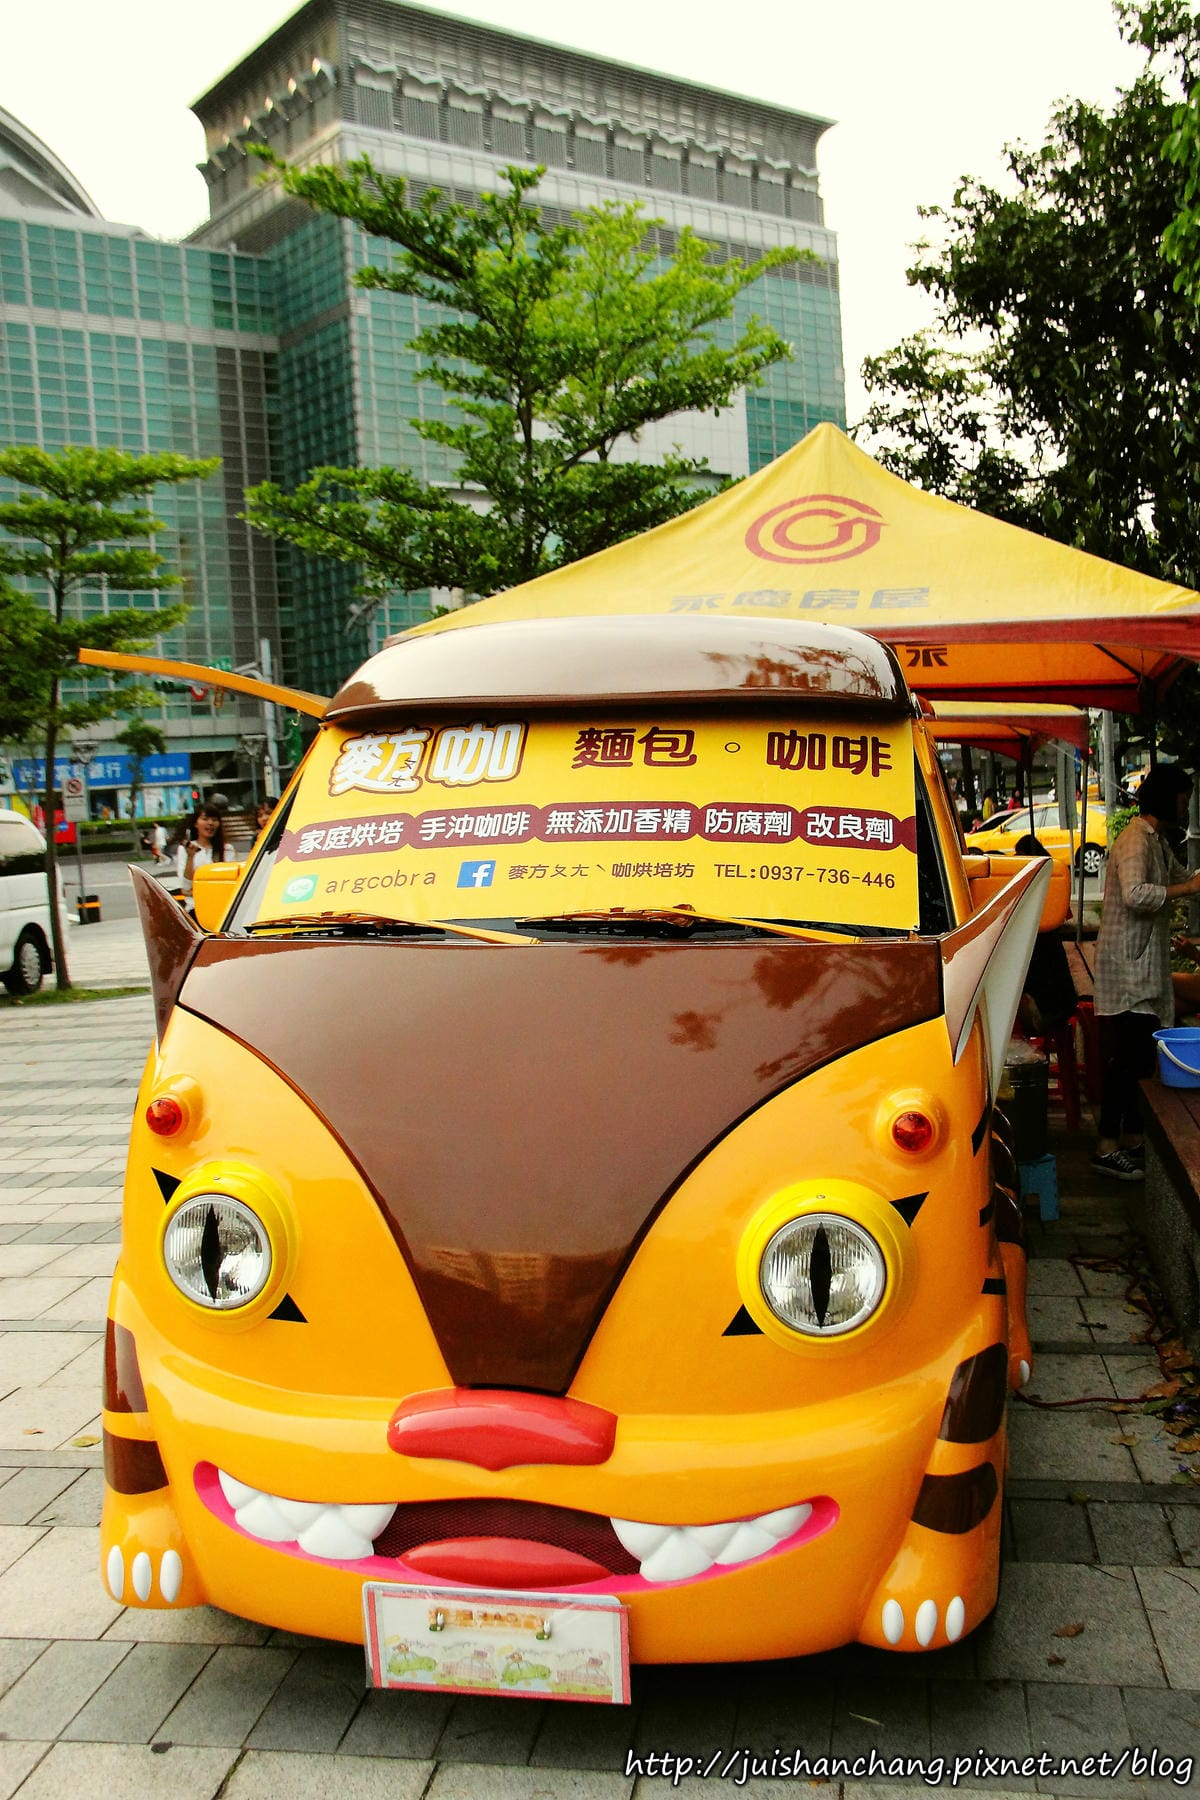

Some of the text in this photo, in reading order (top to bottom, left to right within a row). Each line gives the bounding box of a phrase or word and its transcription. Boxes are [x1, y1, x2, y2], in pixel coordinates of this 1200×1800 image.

[571, 726, 893, 777] 麵包 咖啡
[296, 808, 894, 854] 家庭烘培 手沖咖啡 無添加香精 防腐劑 改良劑
[325, 869, 437, 894] argcobra
[714, 864, 896, 889] TEL:0937-736-446
